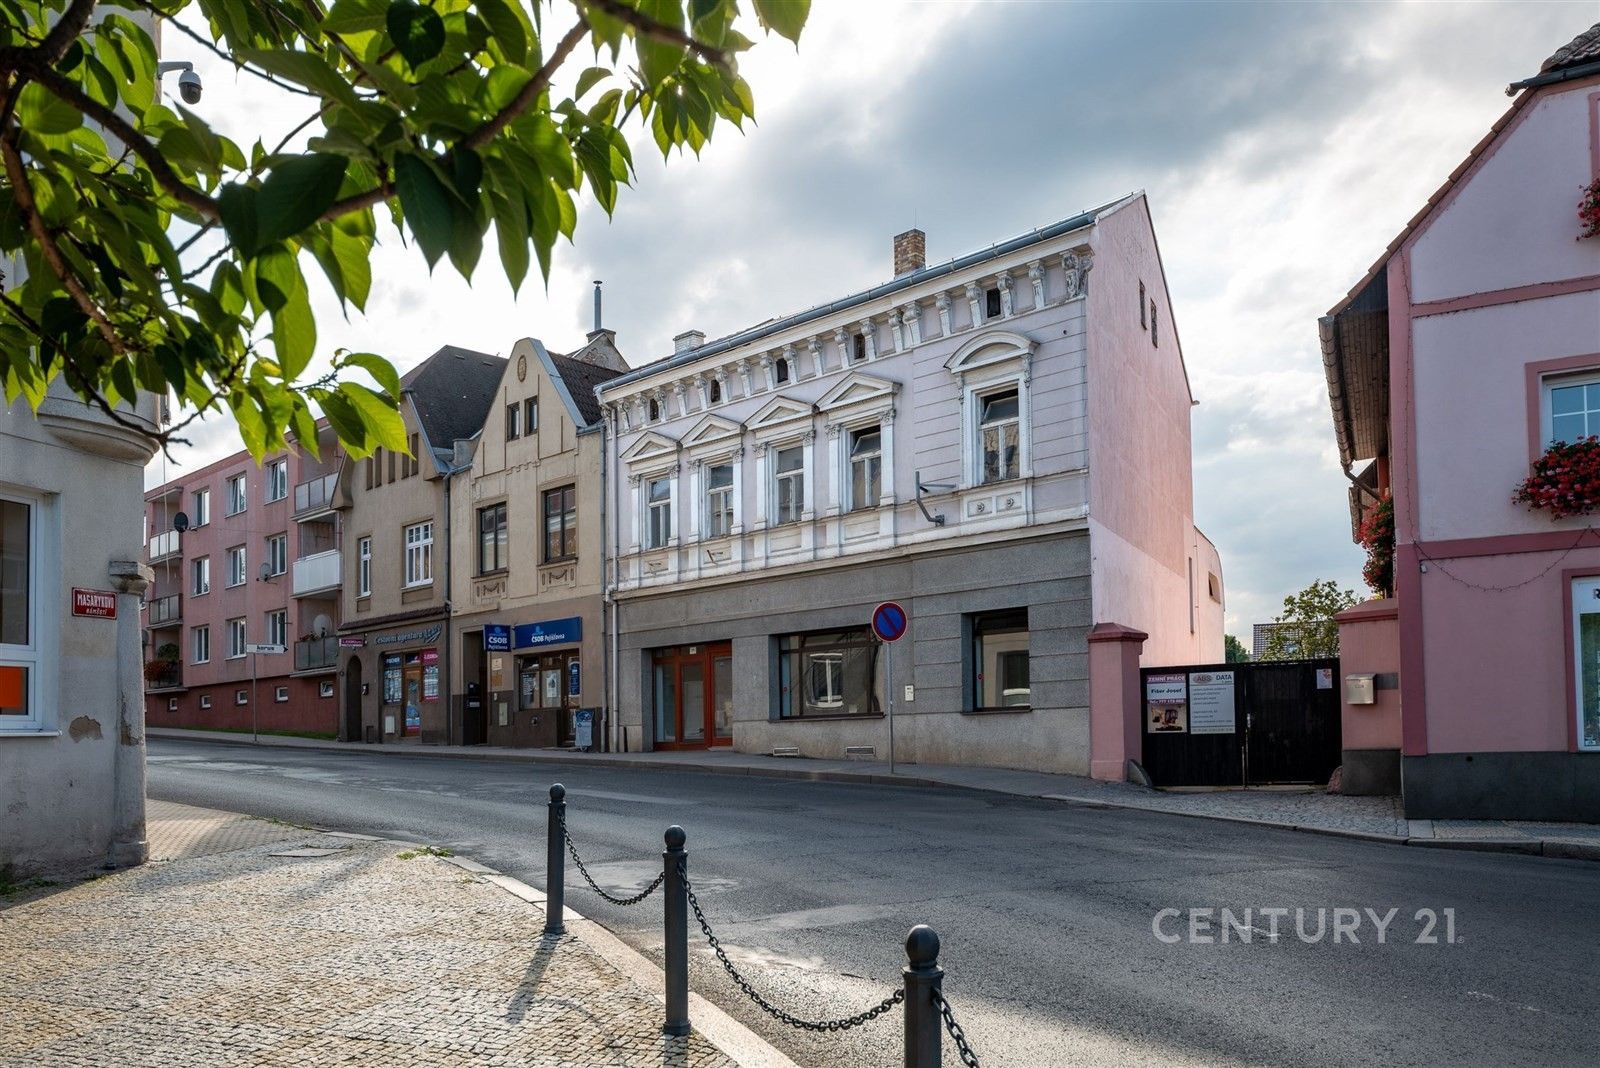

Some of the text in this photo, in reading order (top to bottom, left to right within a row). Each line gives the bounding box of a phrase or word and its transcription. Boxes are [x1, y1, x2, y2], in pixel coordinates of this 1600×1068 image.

[77, 593, 114, 608] MASARYKOVO
[488, 635, 507, 644] ČSOB
[531, 635, 545, 643] ČSOB
